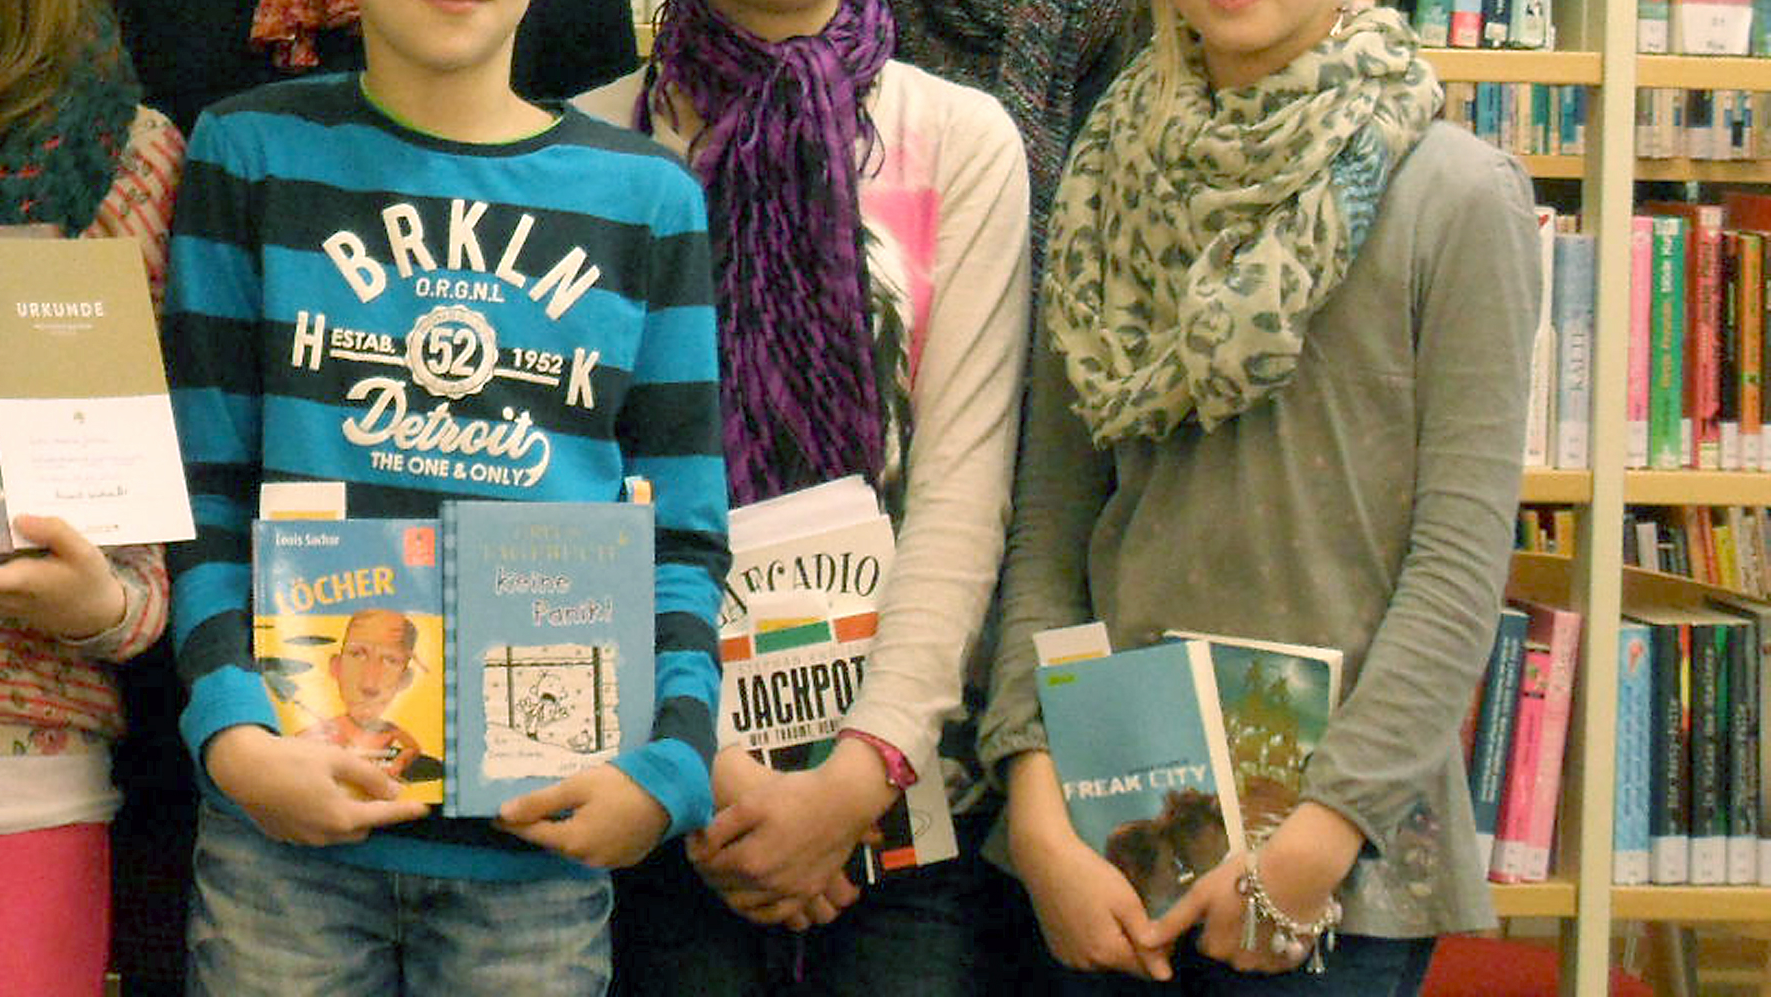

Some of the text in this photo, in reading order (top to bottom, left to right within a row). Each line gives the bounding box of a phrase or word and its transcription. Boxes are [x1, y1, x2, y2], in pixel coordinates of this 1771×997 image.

[322, 198, 600, 321] BRKLN
[16, 301, 105, 318] URKUNDE
[292, 310, 600, 409] H ESTAB. 52 1952 K
[342, 376, 551, 487] Detroit
[370, 451, 525, 486] THE ONE & ONLY
[274, 565, 396, 613] LÖCHER
[732, 655, 866, 732] JACKPOT
[1063, 774, 1143, 801] FREAK
[1149, 764, 1206, 788] CITY
